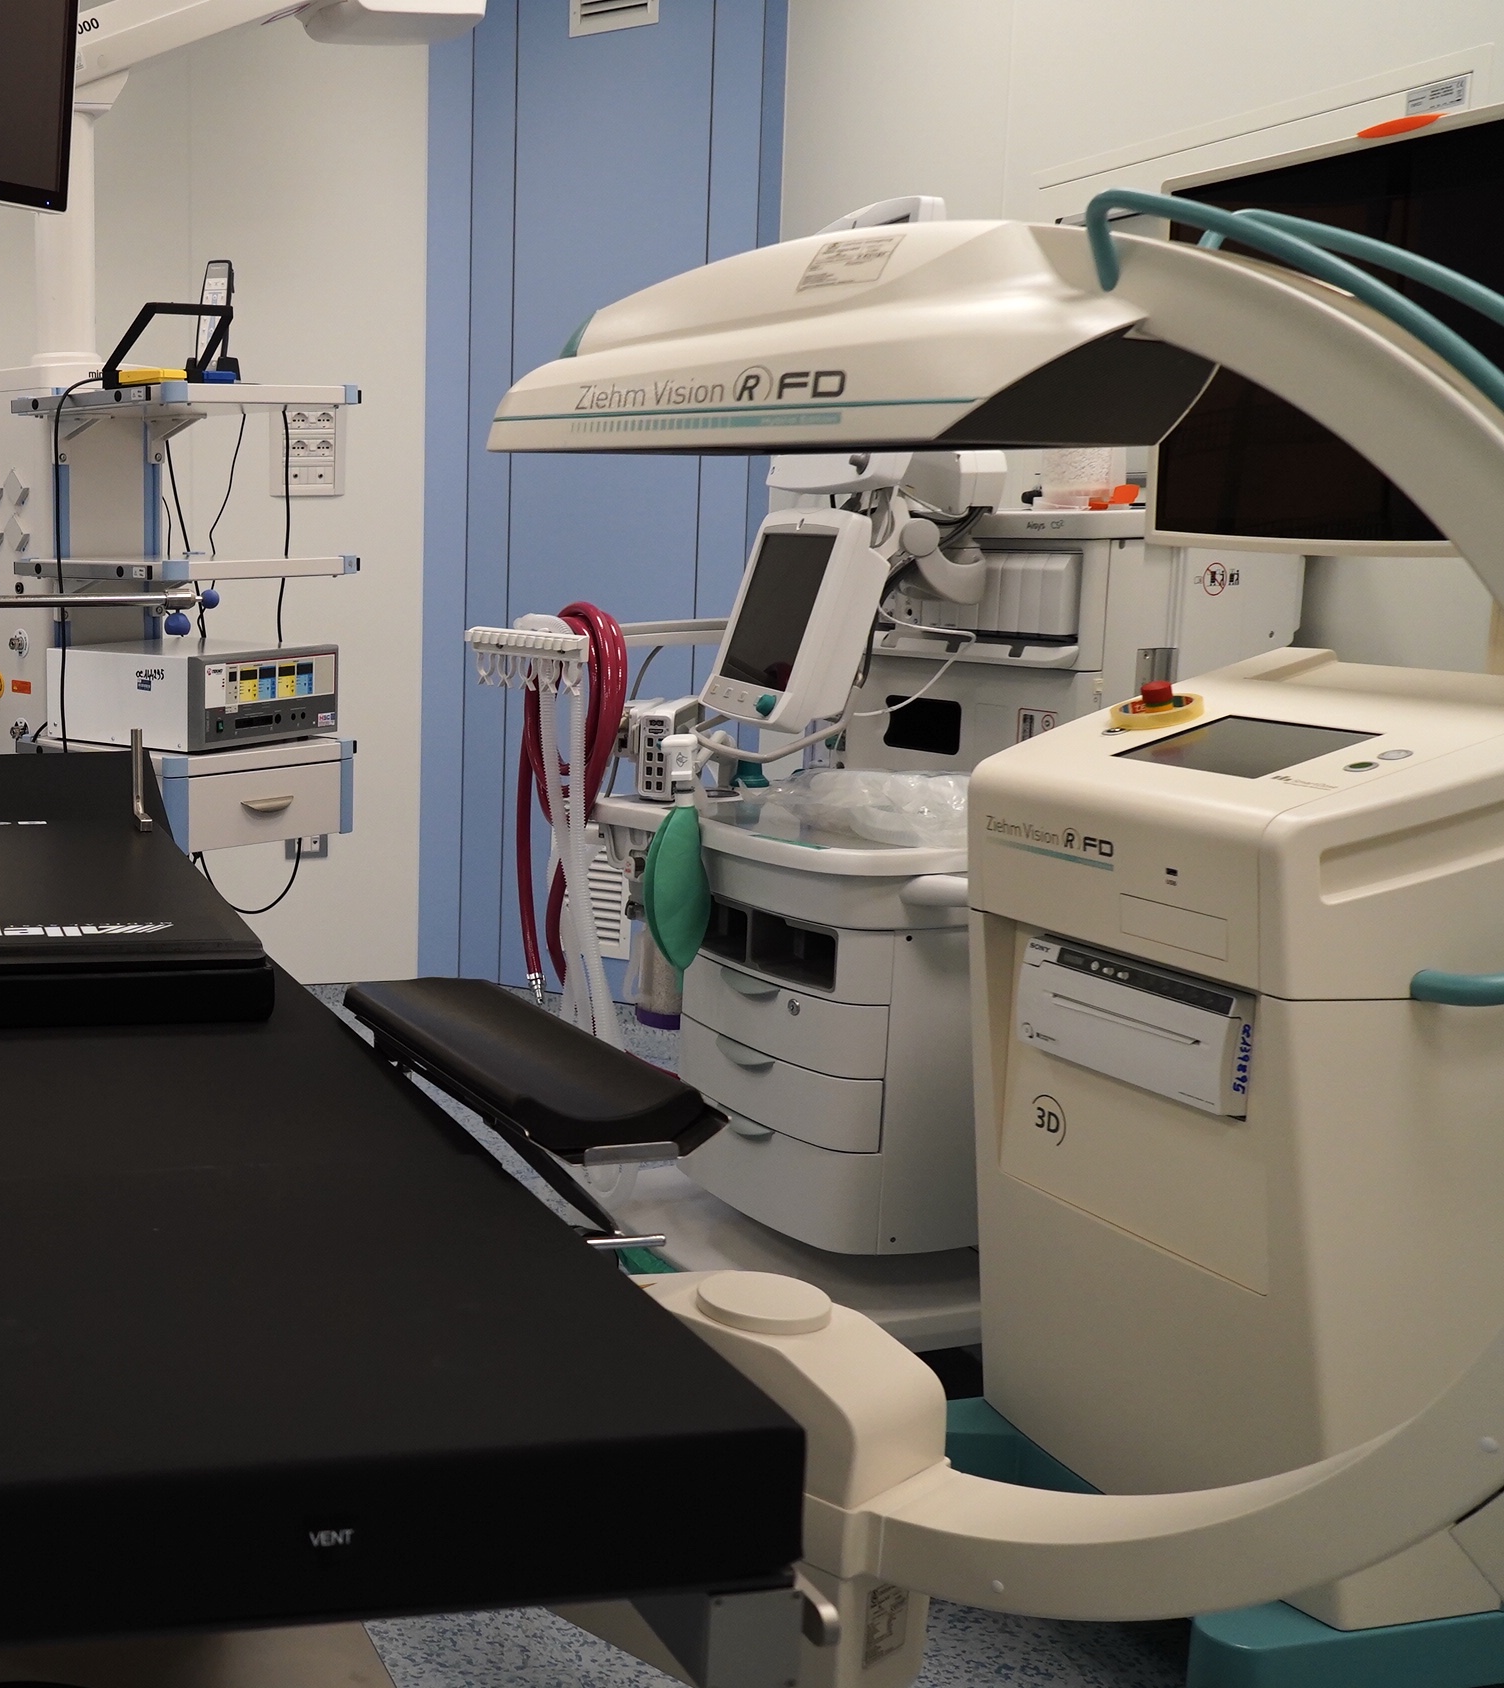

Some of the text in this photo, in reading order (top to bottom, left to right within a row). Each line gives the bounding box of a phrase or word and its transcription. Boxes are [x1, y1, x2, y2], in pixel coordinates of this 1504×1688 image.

[574, 383, 646, 411] Ziehm
[652, 378, 724, 406] Vision
[776, 370, 846, 400] FD
[985, 814, 1022, 838] Ziehm
[1022, 822, 1060, 847] Vision
[1082, 836, 1114, 858] FD
[1029, 942, 1051, 952] SONY
[1035, 1106, 1060, 1134] 3D
[308, 1528, 355, 1547] VENT
